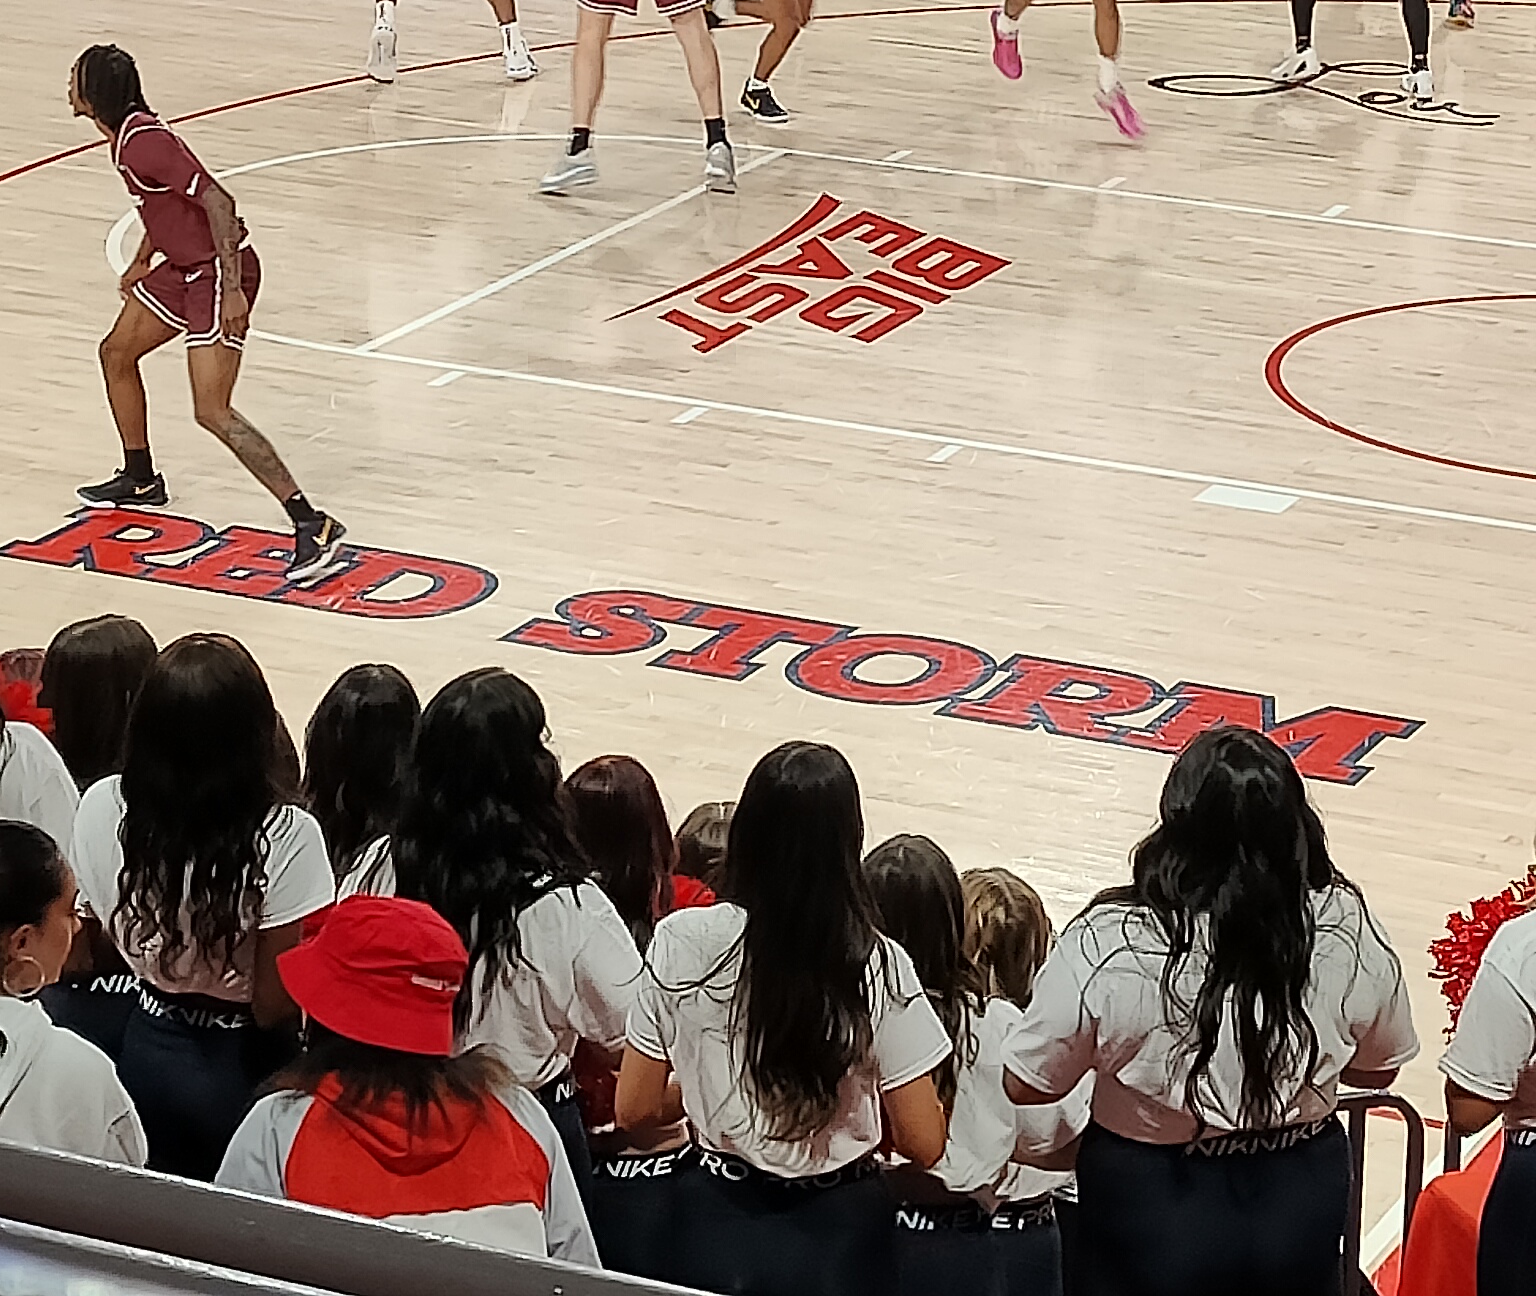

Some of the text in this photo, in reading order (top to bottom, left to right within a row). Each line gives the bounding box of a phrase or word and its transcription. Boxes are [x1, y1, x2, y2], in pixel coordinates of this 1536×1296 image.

[655, 209, 928, 354] EAST
[797, 234, 1013, 346] BIG
[497, 588, 1428, 787] STORM
